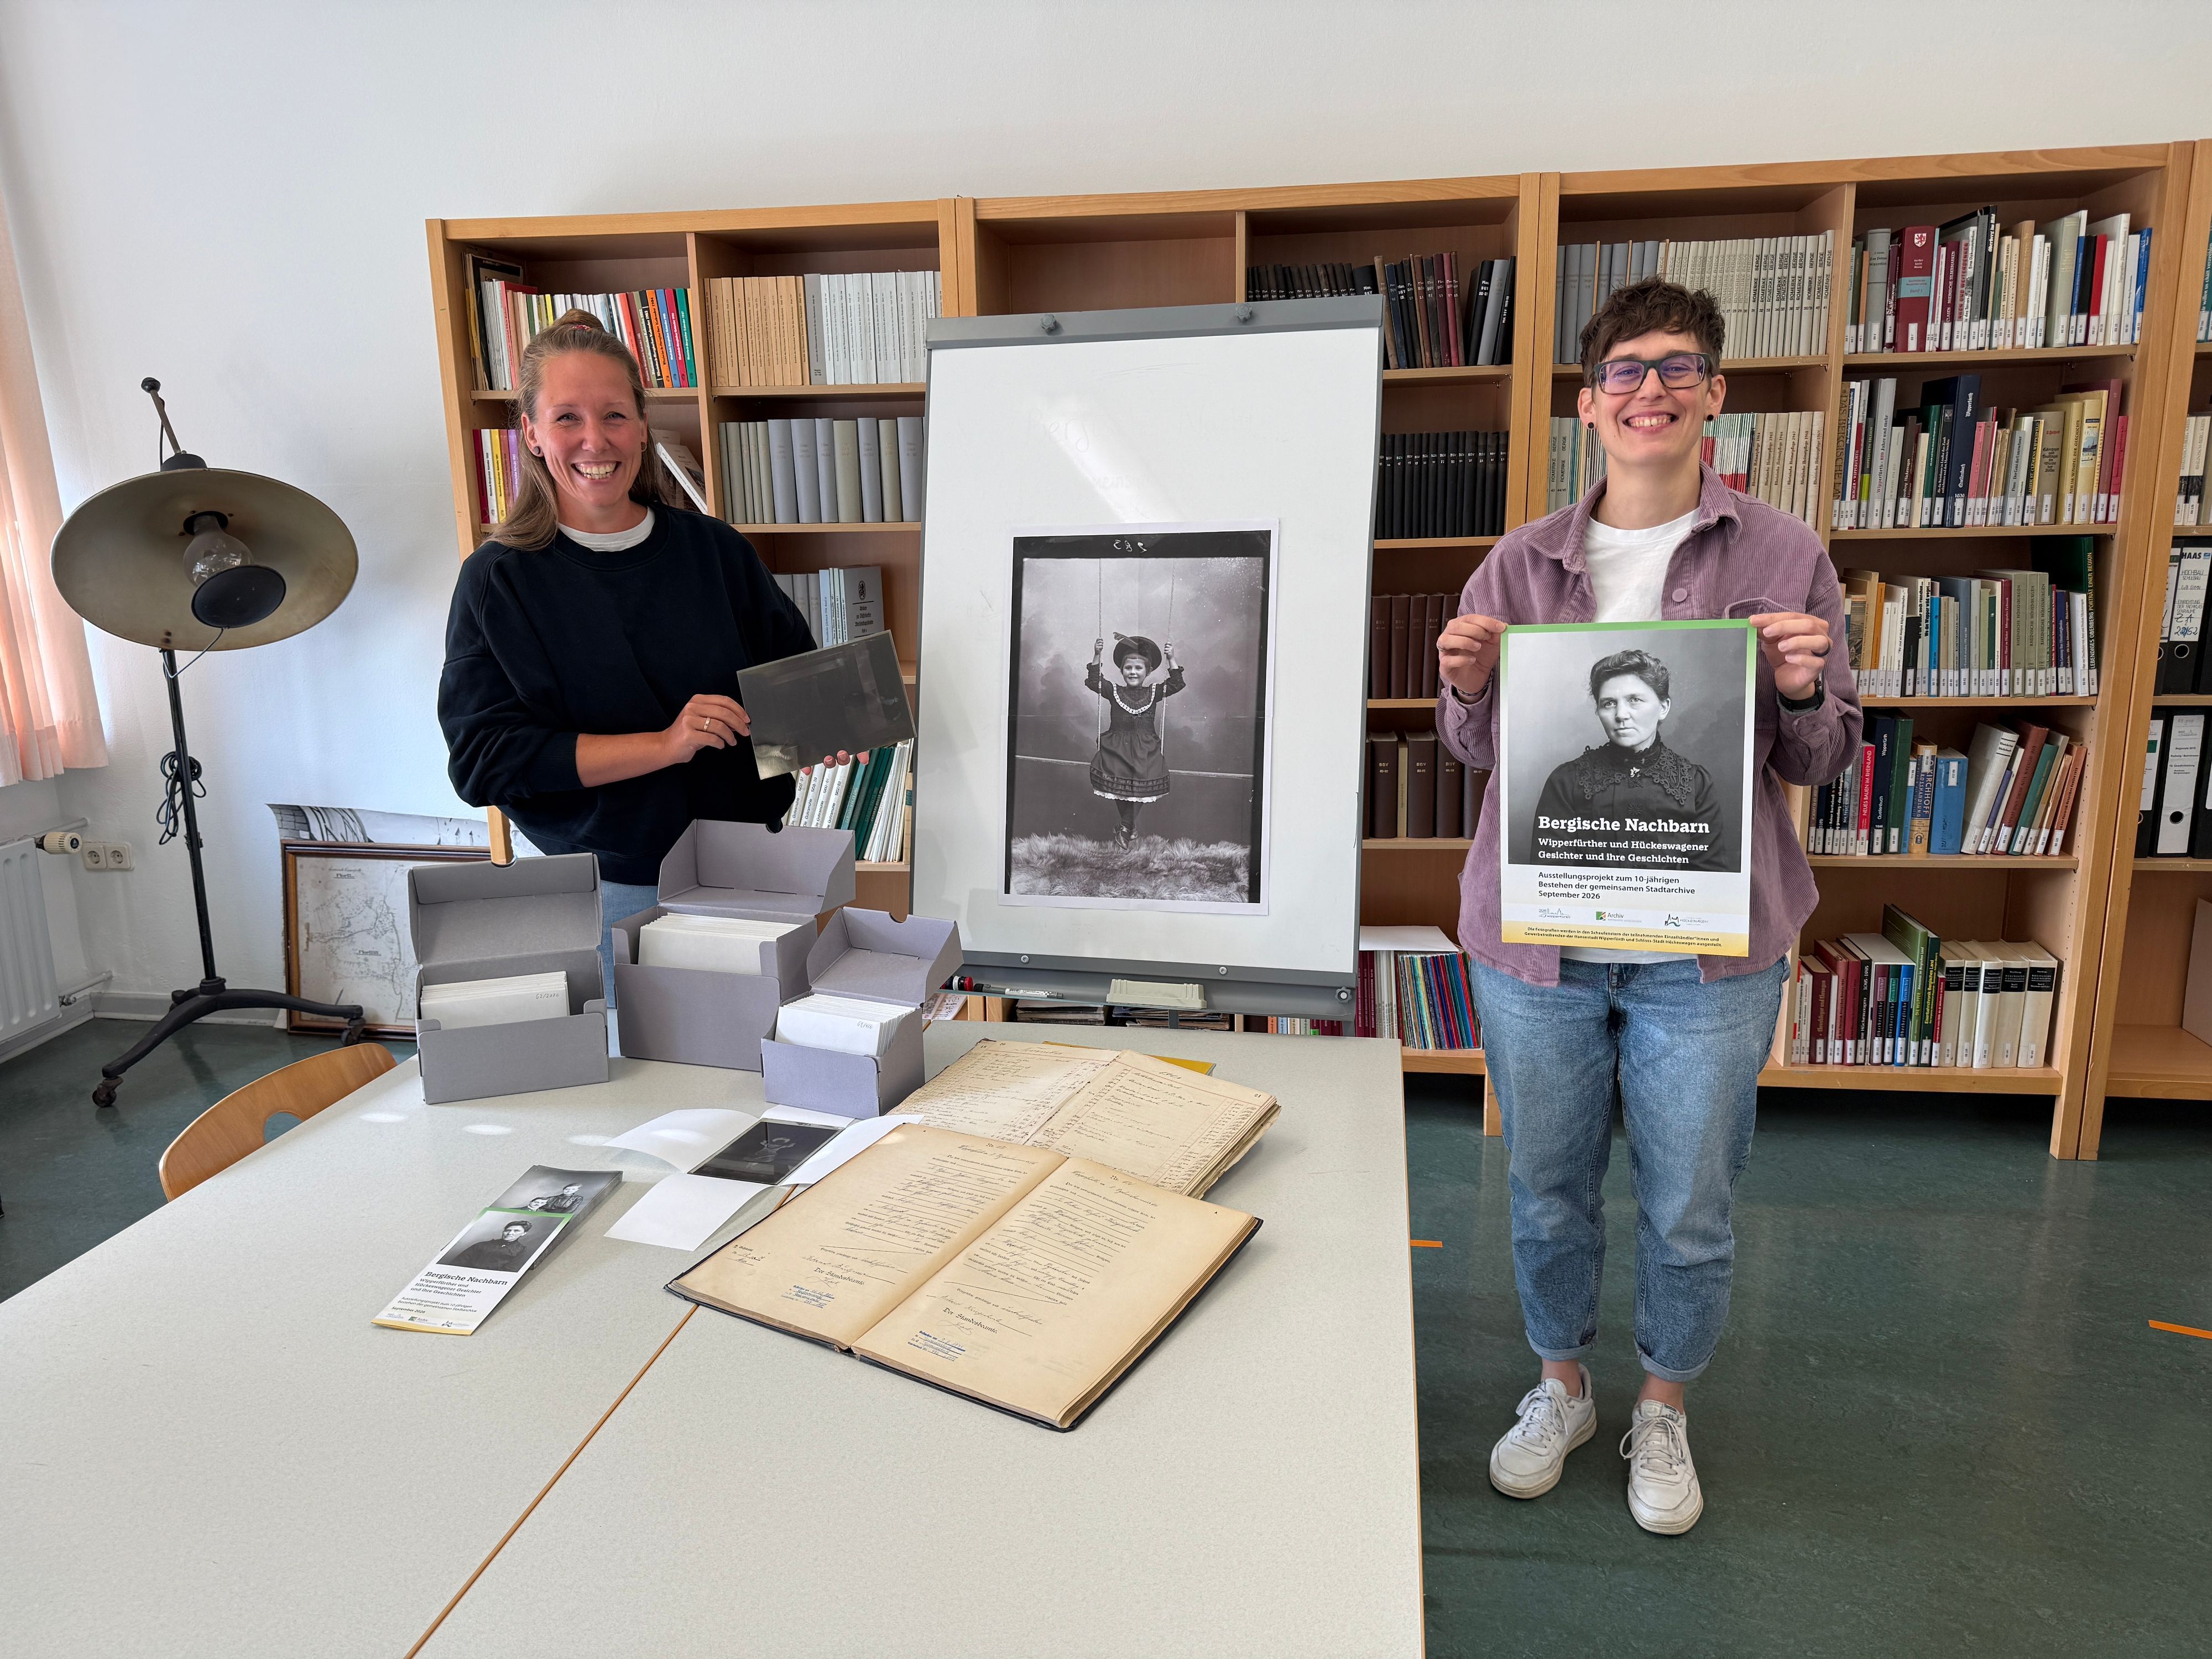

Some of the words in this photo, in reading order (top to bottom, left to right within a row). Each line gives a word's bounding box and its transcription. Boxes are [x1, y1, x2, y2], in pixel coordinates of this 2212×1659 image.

[1839, 395, 1848, 415] DAS
[1835, 419, 1846, 469] BERGISCHE
[1923, 770, 1933, 815] KIRCHHOFF
[1538, 816, 1620, 832] Bergische
[1625, 818, 1710, 833] Nachbarn
[1538, 838, 1607, 848] Wipperfürther
[1631, 841, 1709, 852] Hückeswagener
[1538, 851, 1583, 860] Gesichter
[1606, 853, 1625, 862] ihre
[1628, 854, 1689, 864] Geschichten
[1538, 872, 1614, 882] Ausstellungsprojekt
[1635, 875, 1679, 885] 10-jährigen
[1538, 890, 1580, 899] September
[1646, 886, 1695, 894] Stadtarchive
[420, 1278, 457, 1287] Wipperfürther
[425, 1271, 466, 1282] Bergische
[467, 1276, 508, 1286] Nachbarn
[414, 1283, 456, 1292] Hückeswagener
[943, 1307, 954, 1316] Der
[956, 1312, 998, 1334] Standesbeamte.
